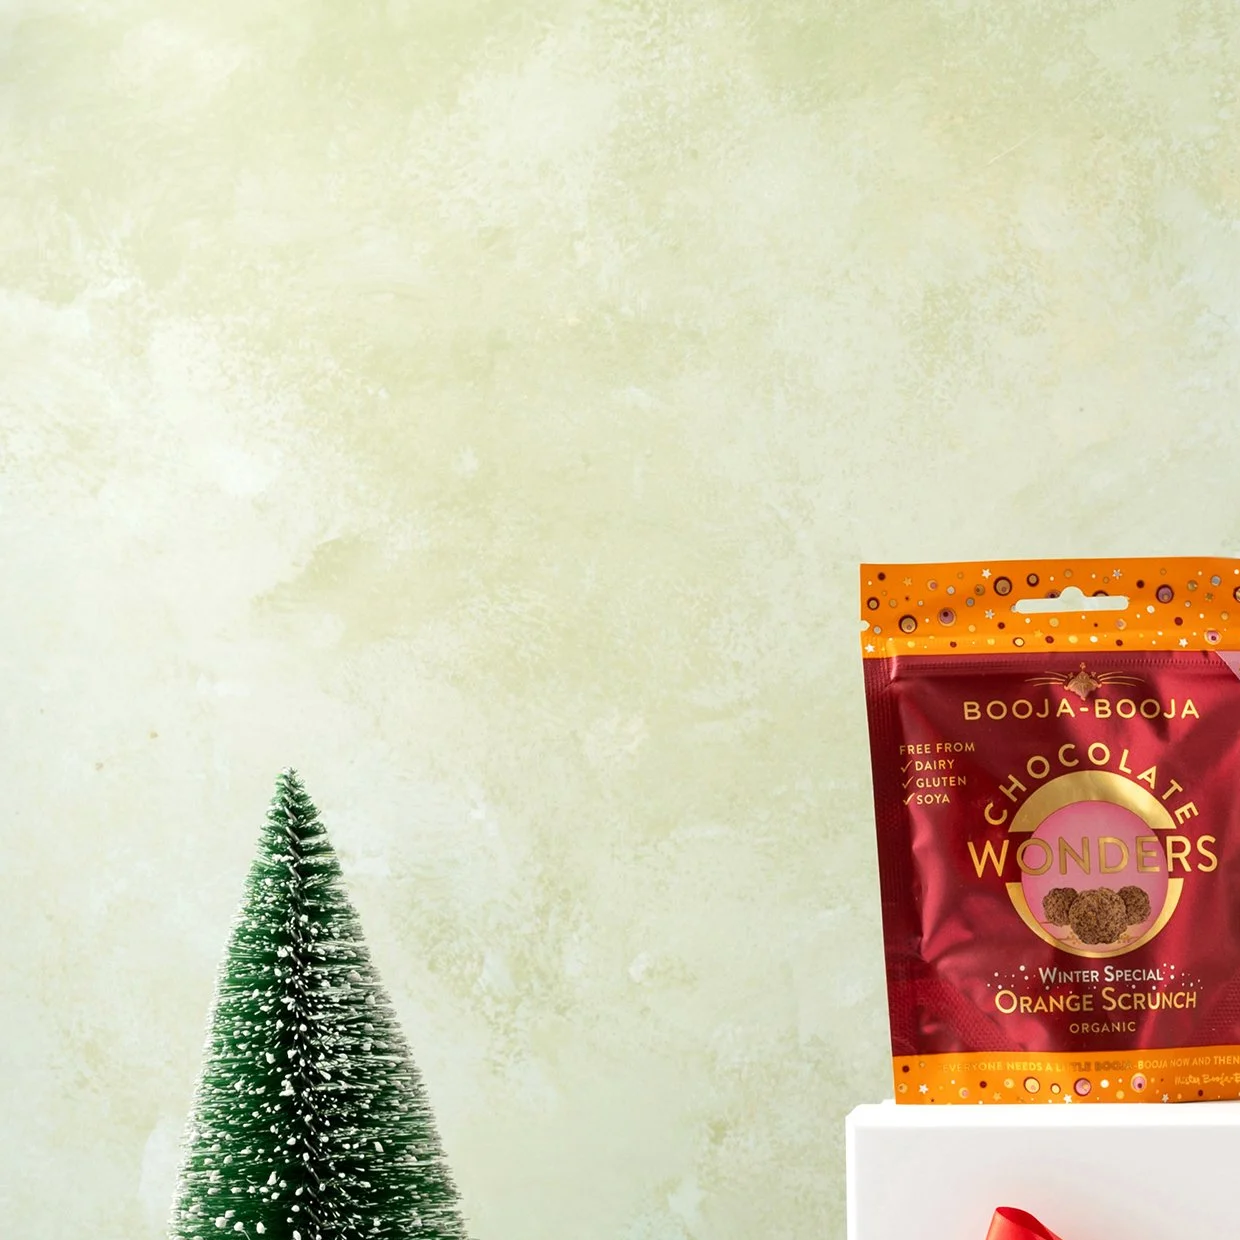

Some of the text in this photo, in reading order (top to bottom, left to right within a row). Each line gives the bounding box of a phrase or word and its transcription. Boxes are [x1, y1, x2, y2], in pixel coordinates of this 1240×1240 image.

[963, 698, 1200, 721] BOOJA-BOOJA
[899, 742, 976, 756] FREE FROM
[915, 760, 954, 772] DAIRY
[916, 776, 967, 789] GLUTEN
[984, 742, 1200, 826] CHOCOLATE
[916, 793, 950, 806] SOYA
[967, 835, 1219, 878] WONDERS
[1039, 965, 1164, 983] WINTER SPECIAL
[995, 987, 1197, 1014] ORANGE SCRUNCH
[1069, 1020, 1137, 1035] ORGANIC
[1007, 1062, 1042, 1072] NEEDS
[1045, 1063, 1053, 1073] A
[1170, 1057, 1190, 1067] NOW
[1192, 1056, 1211, 1066] AND
